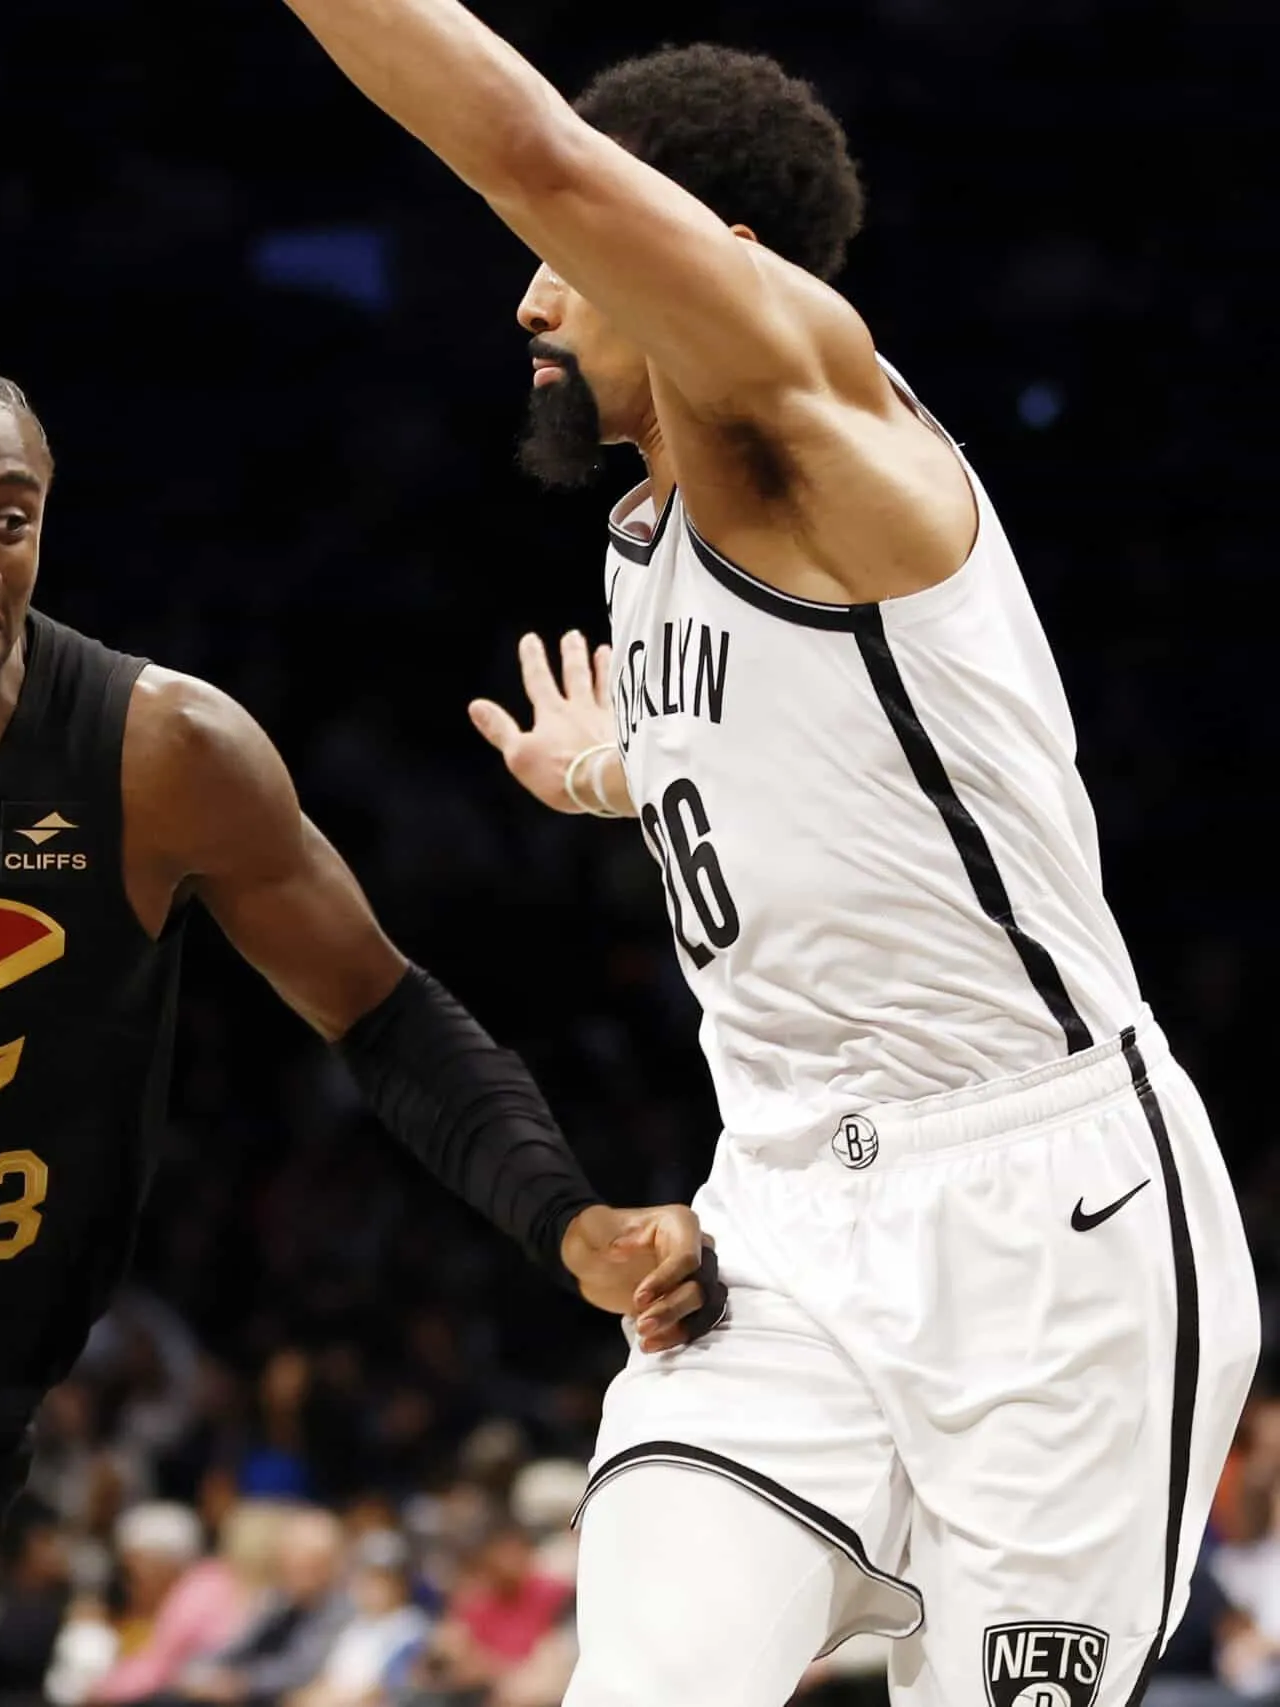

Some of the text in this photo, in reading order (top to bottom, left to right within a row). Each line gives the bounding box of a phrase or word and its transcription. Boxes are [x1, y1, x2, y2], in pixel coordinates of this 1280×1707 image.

[4, 853, 87, 870] CLIFFS
[641, 778, 740, 970] 26
[845, 1123, 864, 1161] B
[991, 1631, 1100, 1684] NETS
